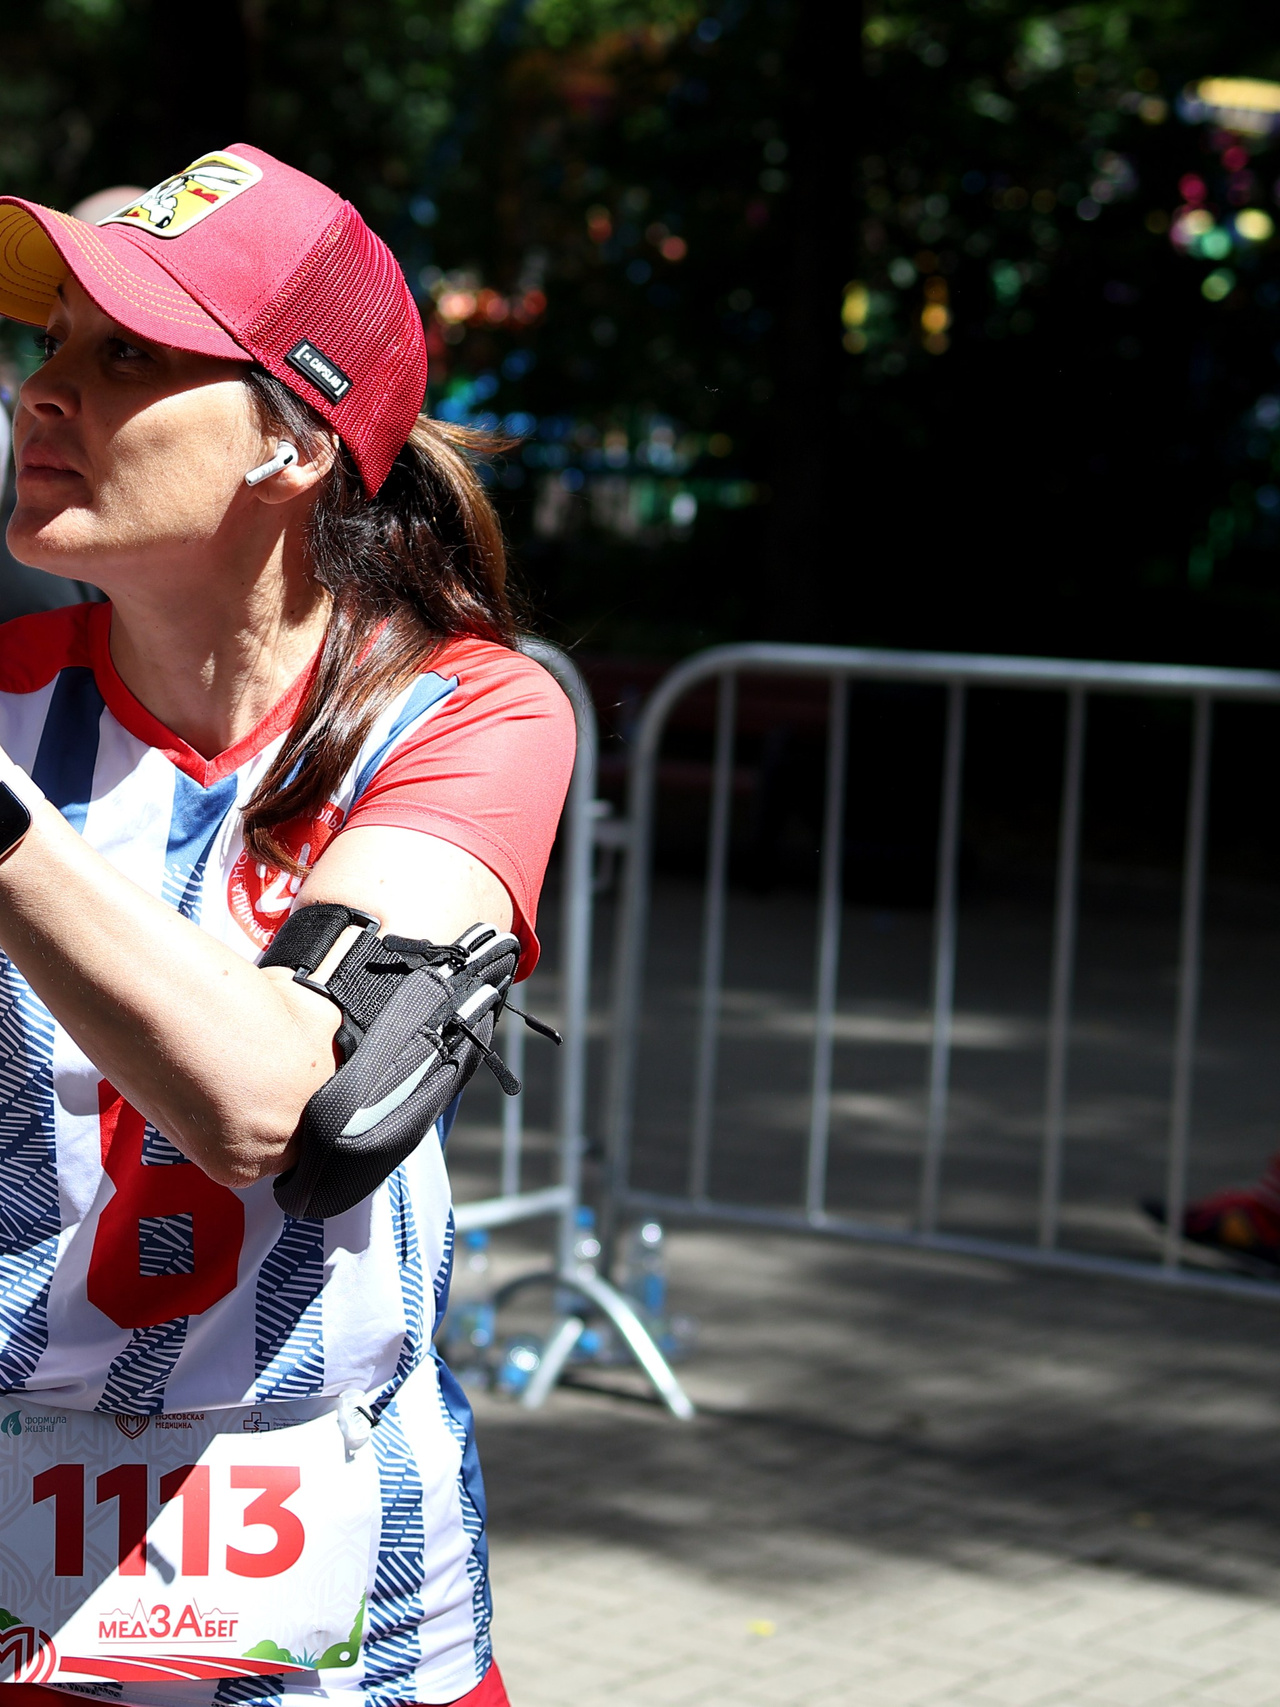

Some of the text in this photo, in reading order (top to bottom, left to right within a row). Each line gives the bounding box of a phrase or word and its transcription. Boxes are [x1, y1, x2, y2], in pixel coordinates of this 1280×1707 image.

[231, 882, 276, 946] ОЛЬНИЦА
[24, 1416, 67, 1426] формула
[155, 1422, 193, 1430] МЕДИЦИНА
[24, 1425, 55, 1433] жизни
[32, 1462, 306, 1578] 1113
